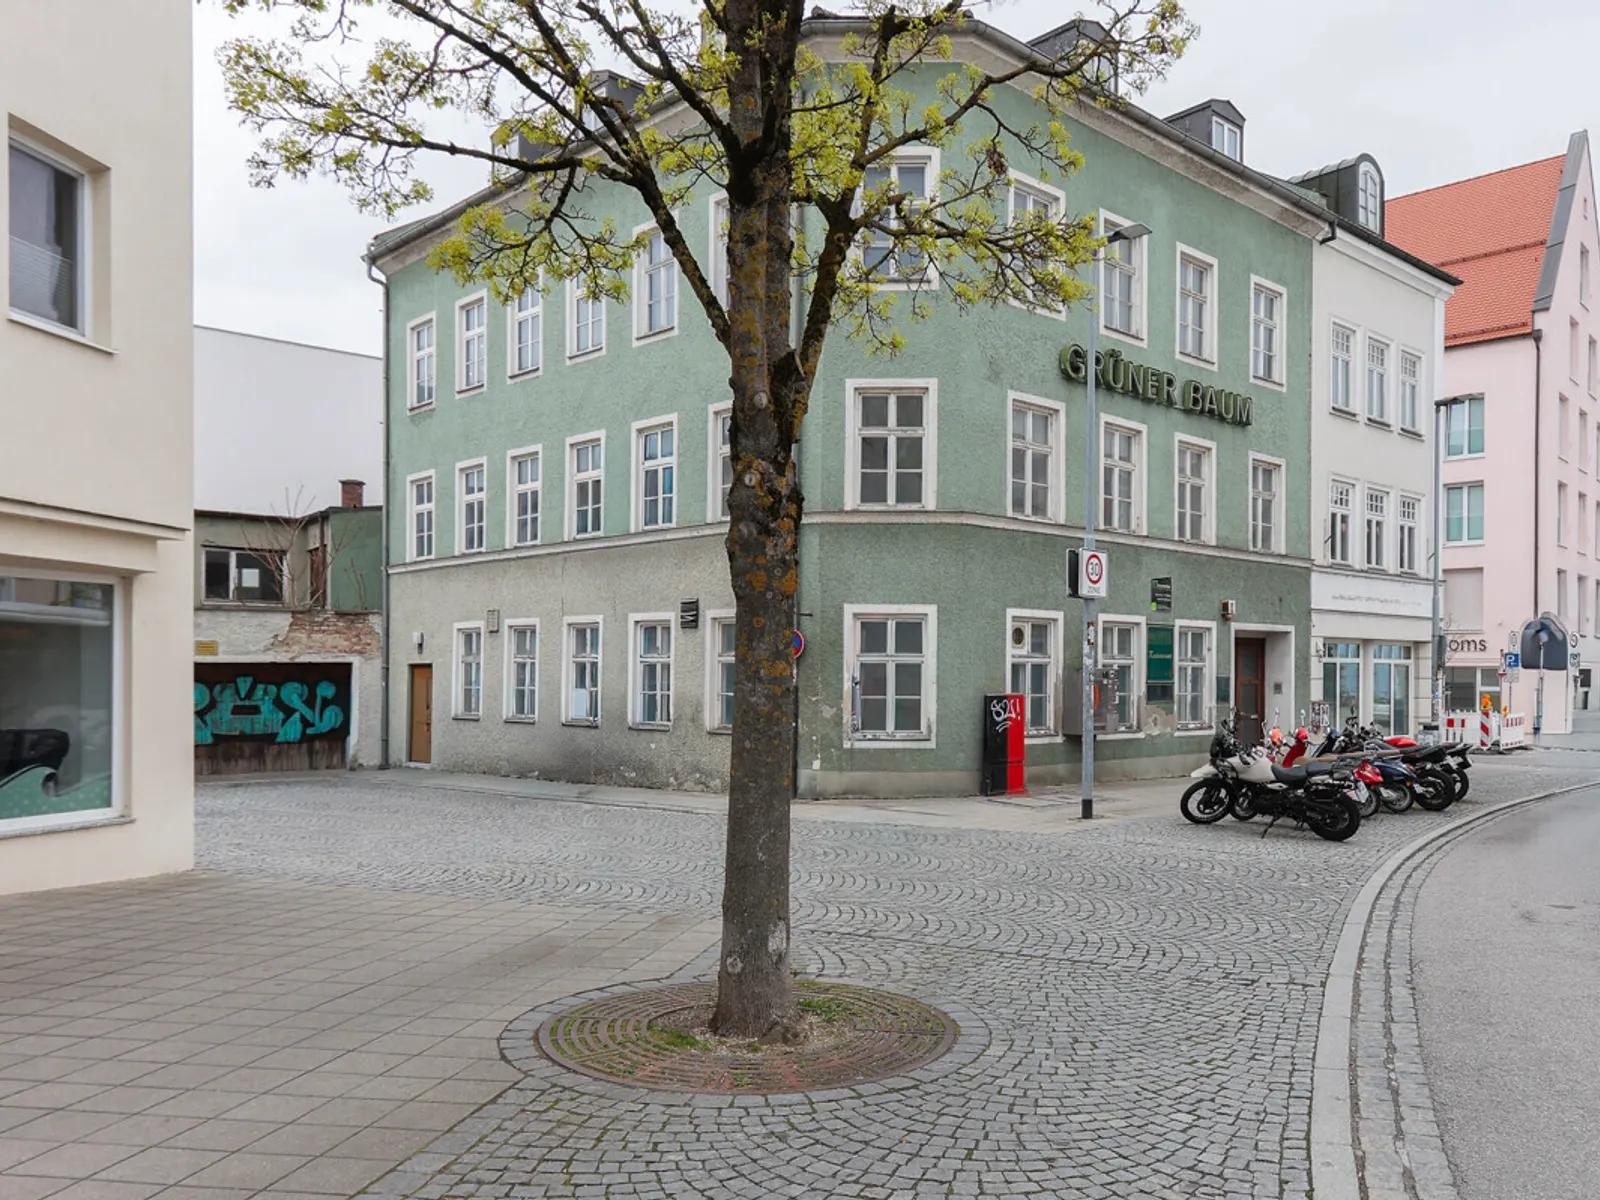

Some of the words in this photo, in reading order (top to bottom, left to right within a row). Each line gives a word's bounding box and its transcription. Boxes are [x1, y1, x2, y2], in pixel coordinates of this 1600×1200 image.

[1059, 343, 1178, 408] GRÜNER
[1184, 379, 1253, 427] BAUM
[1089, 559, 1101, 577] 30
